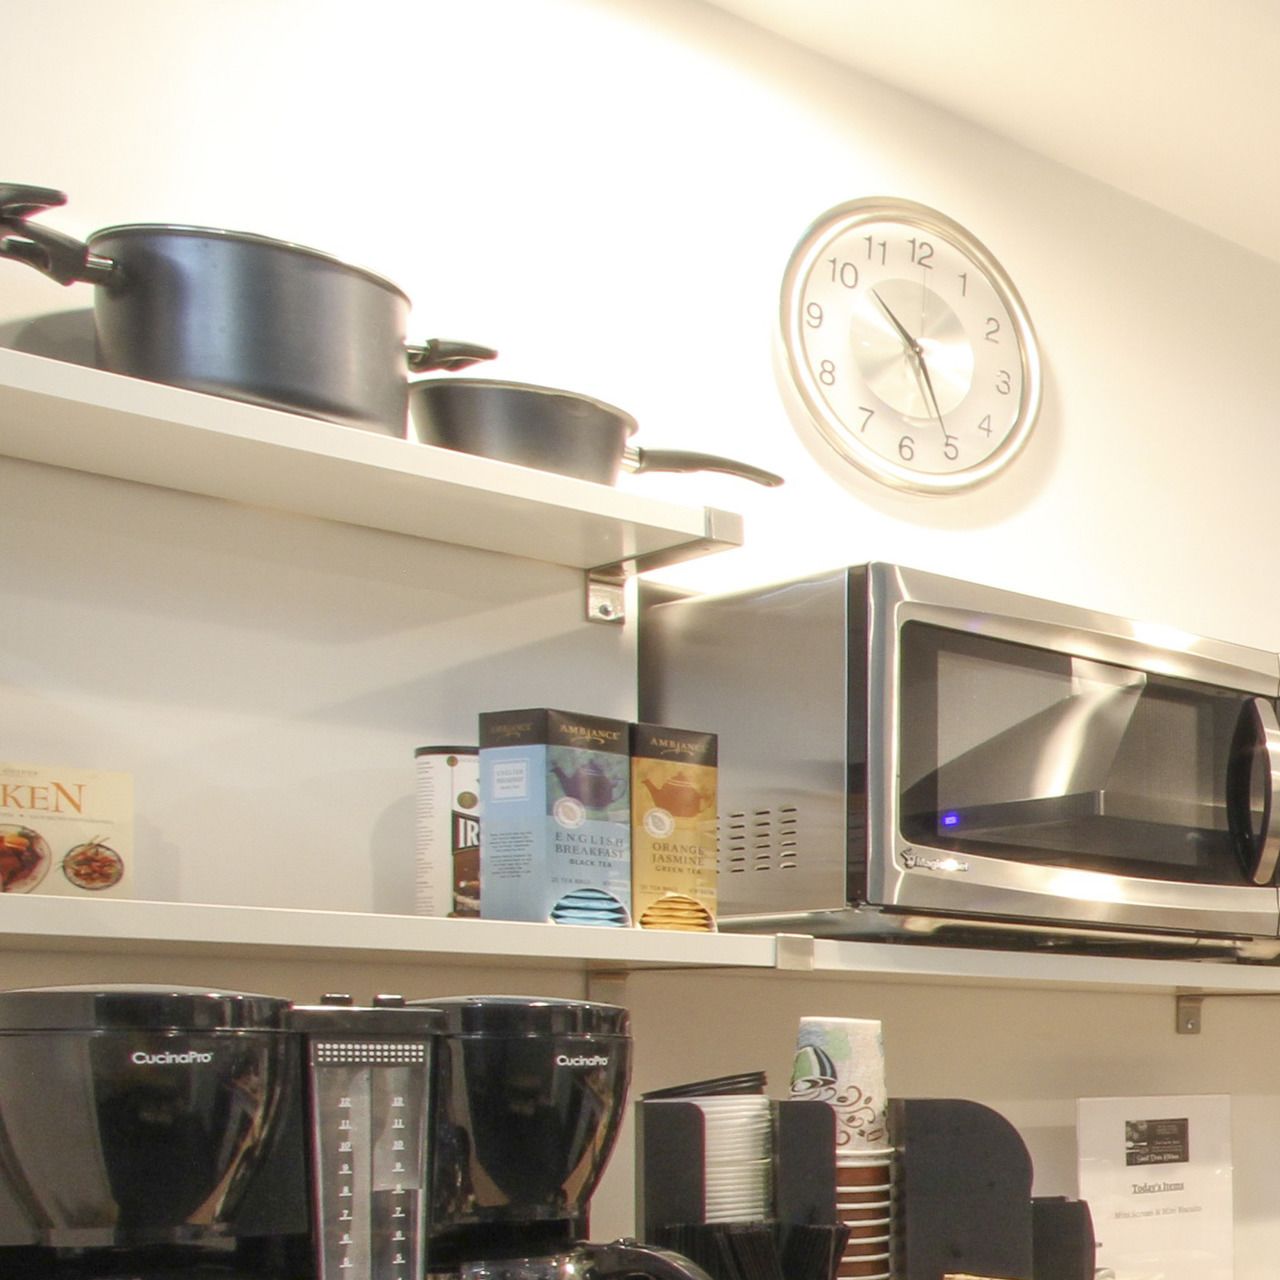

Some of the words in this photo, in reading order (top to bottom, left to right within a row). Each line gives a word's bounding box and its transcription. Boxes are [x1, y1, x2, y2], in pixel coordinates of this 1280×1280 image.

[864, 235, 887, 266] 11
[909, 238, 934, 269] 12
[829, 257, 858, 289] 10
[958, 272, 968, 297] 1
[806, 302, 823, 329] 9
[984, 317, 1000, 344] 2
[819, 360, 836, 386] 8
[995, 370, 1011, 395] 3
[858, 406, 875, 433] 7
[977, 414, 993, 438] 4
[898, 436, 914, 461] 6
[943, 435, 959, 460] 5
[555, 831, 624, 848] ENGLISH
[555, 843, 625, 859] BREAKFAST
[652, 842, 705, 856] ORANGE
[569, 858, 596, 868] BLACK
[598, 860, 613, 869] TEA
[131, 1051, 213, 1065] CucinaPro
[556, 1054, 609, 1066] CucinaPro
[1131, 1182, 1161, 1194] Today's
[1162, 1181, 1184, 1192] Items
